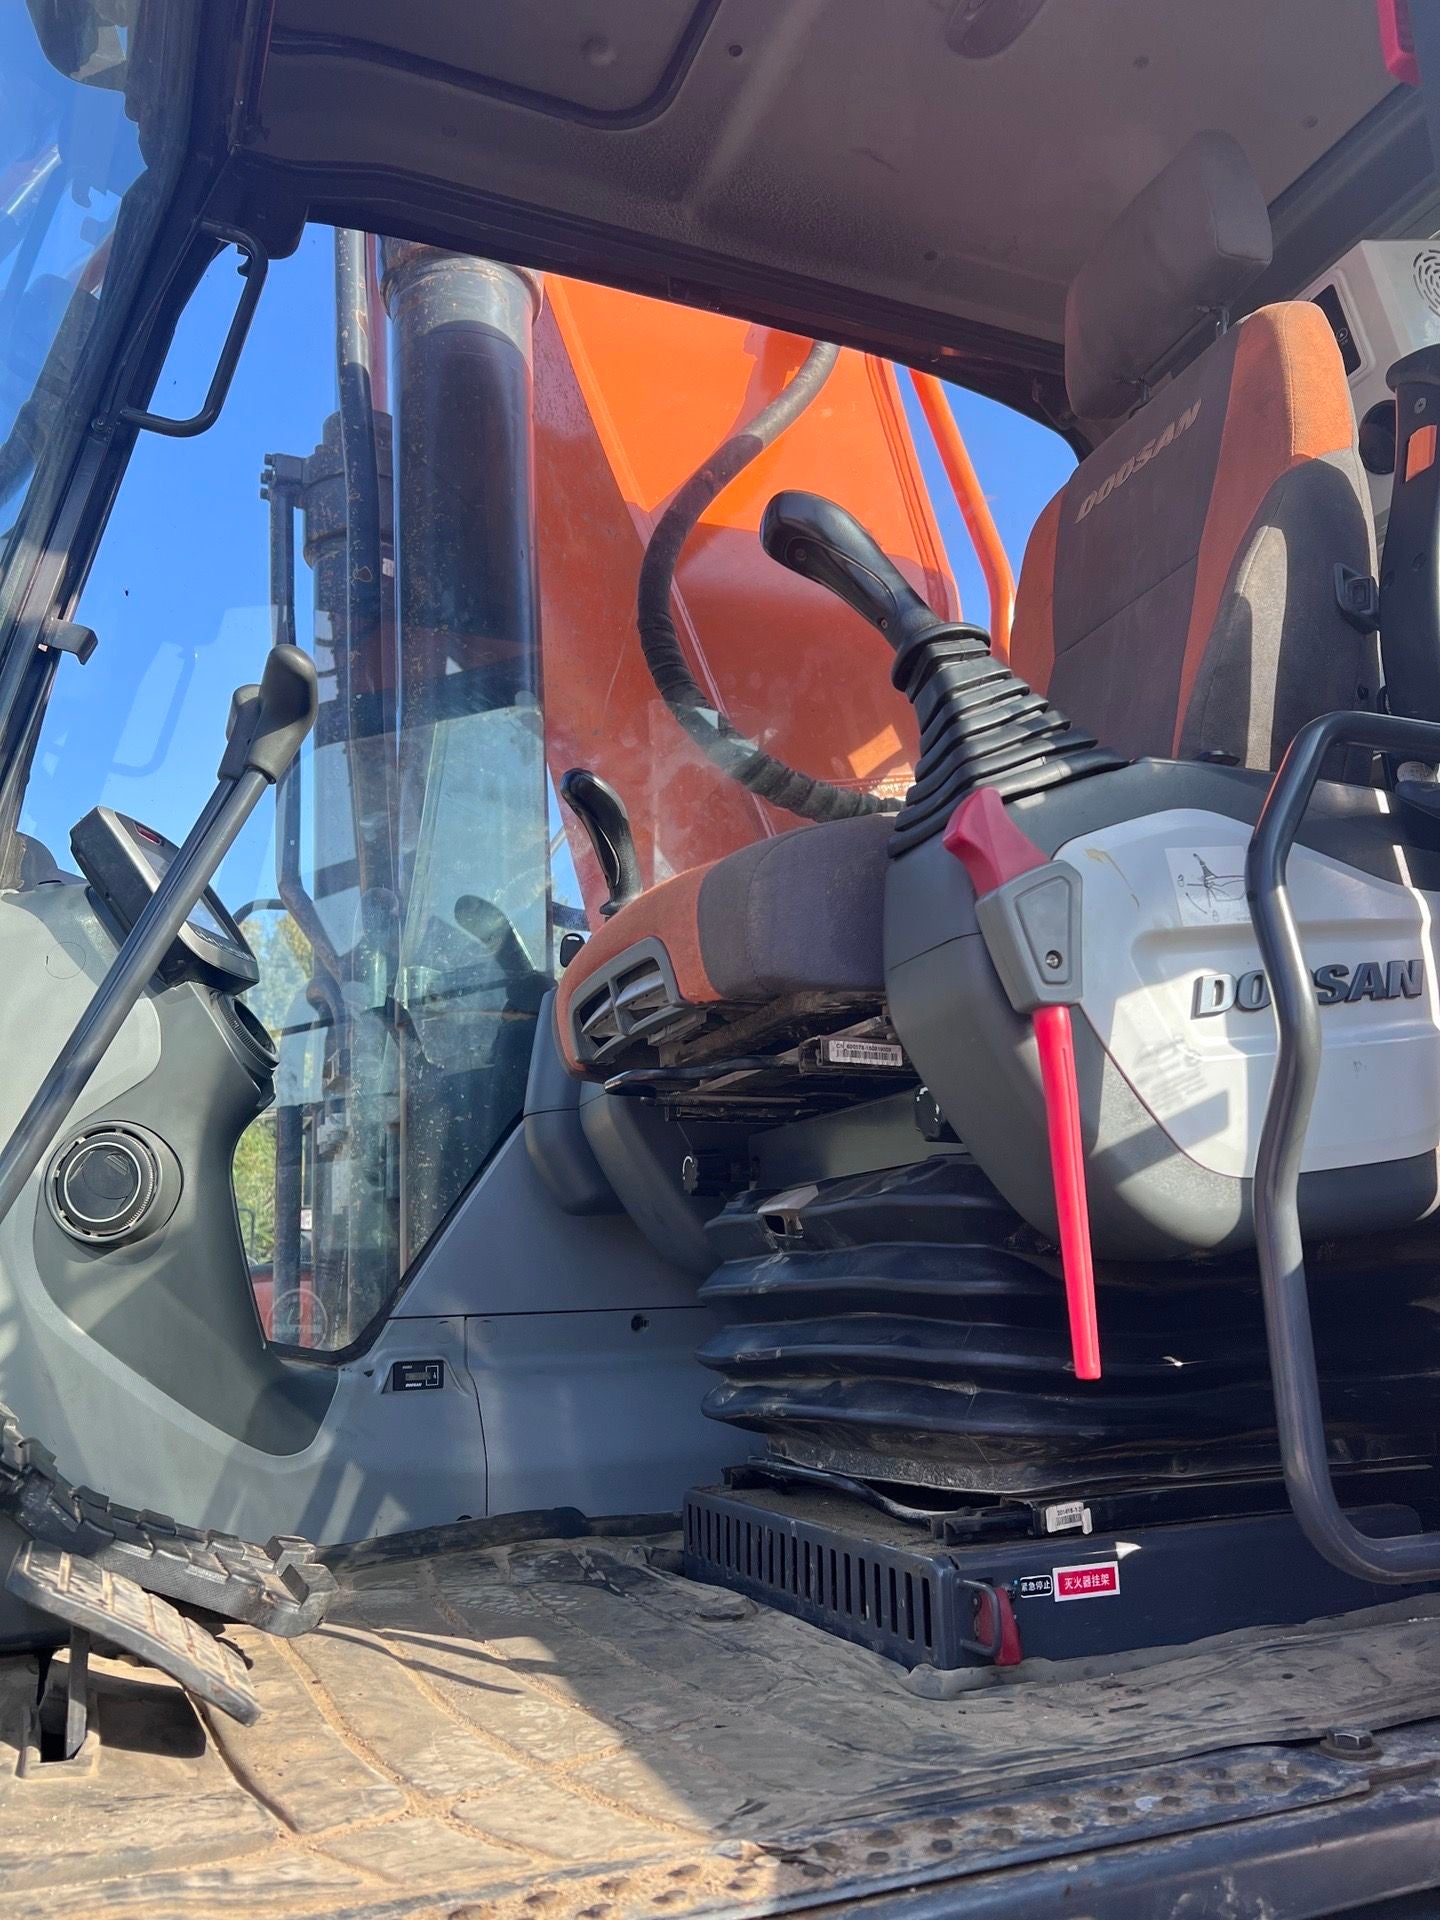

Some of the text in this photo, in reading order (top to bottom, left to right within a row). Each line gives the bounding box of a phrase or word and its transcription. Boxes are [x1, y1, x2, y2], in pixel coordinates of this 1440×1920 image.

[1074, 398, 1202, 524] DOOSAN
[1190, 959, 1424, 1020] DOSAN
[1021, 1580, 1051, 1592] 紧急停止
[1064, 1574, 1110, 1590] 灭火器挂架
